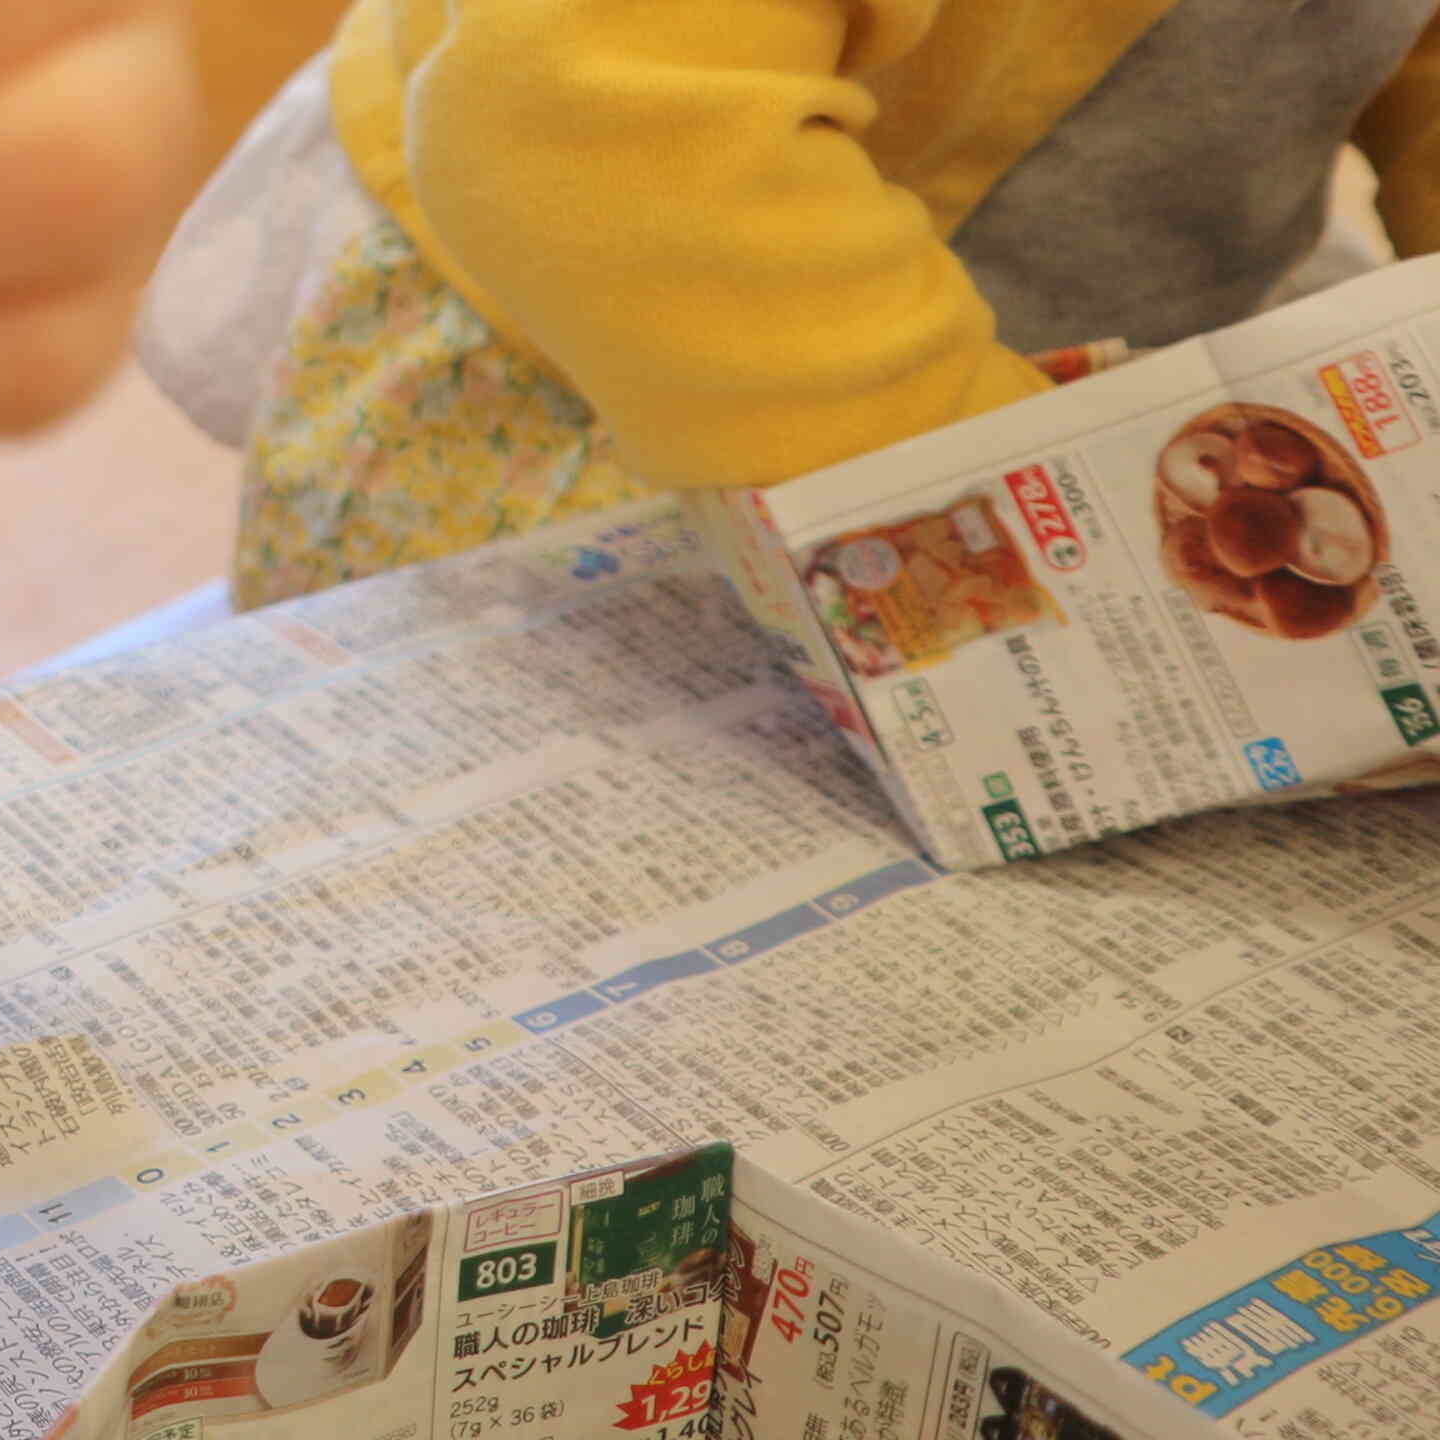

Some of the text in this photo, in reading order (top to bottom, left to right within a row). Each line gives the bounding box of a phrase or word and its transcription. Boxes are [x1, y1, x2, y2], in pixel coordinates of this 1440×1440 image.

[133, 1160, 166, 1190] 0
[37, 1195, 73, 1229] 11
[473, 1223, 536, 1244] コーヒー
[475, 1252, 538, 1289] 803
[452, 1307, 601, 1360] 職人の珈琲
[1139, 1353, 1220, 1409] pt
[450, 1395, 500, 1420] 252g
